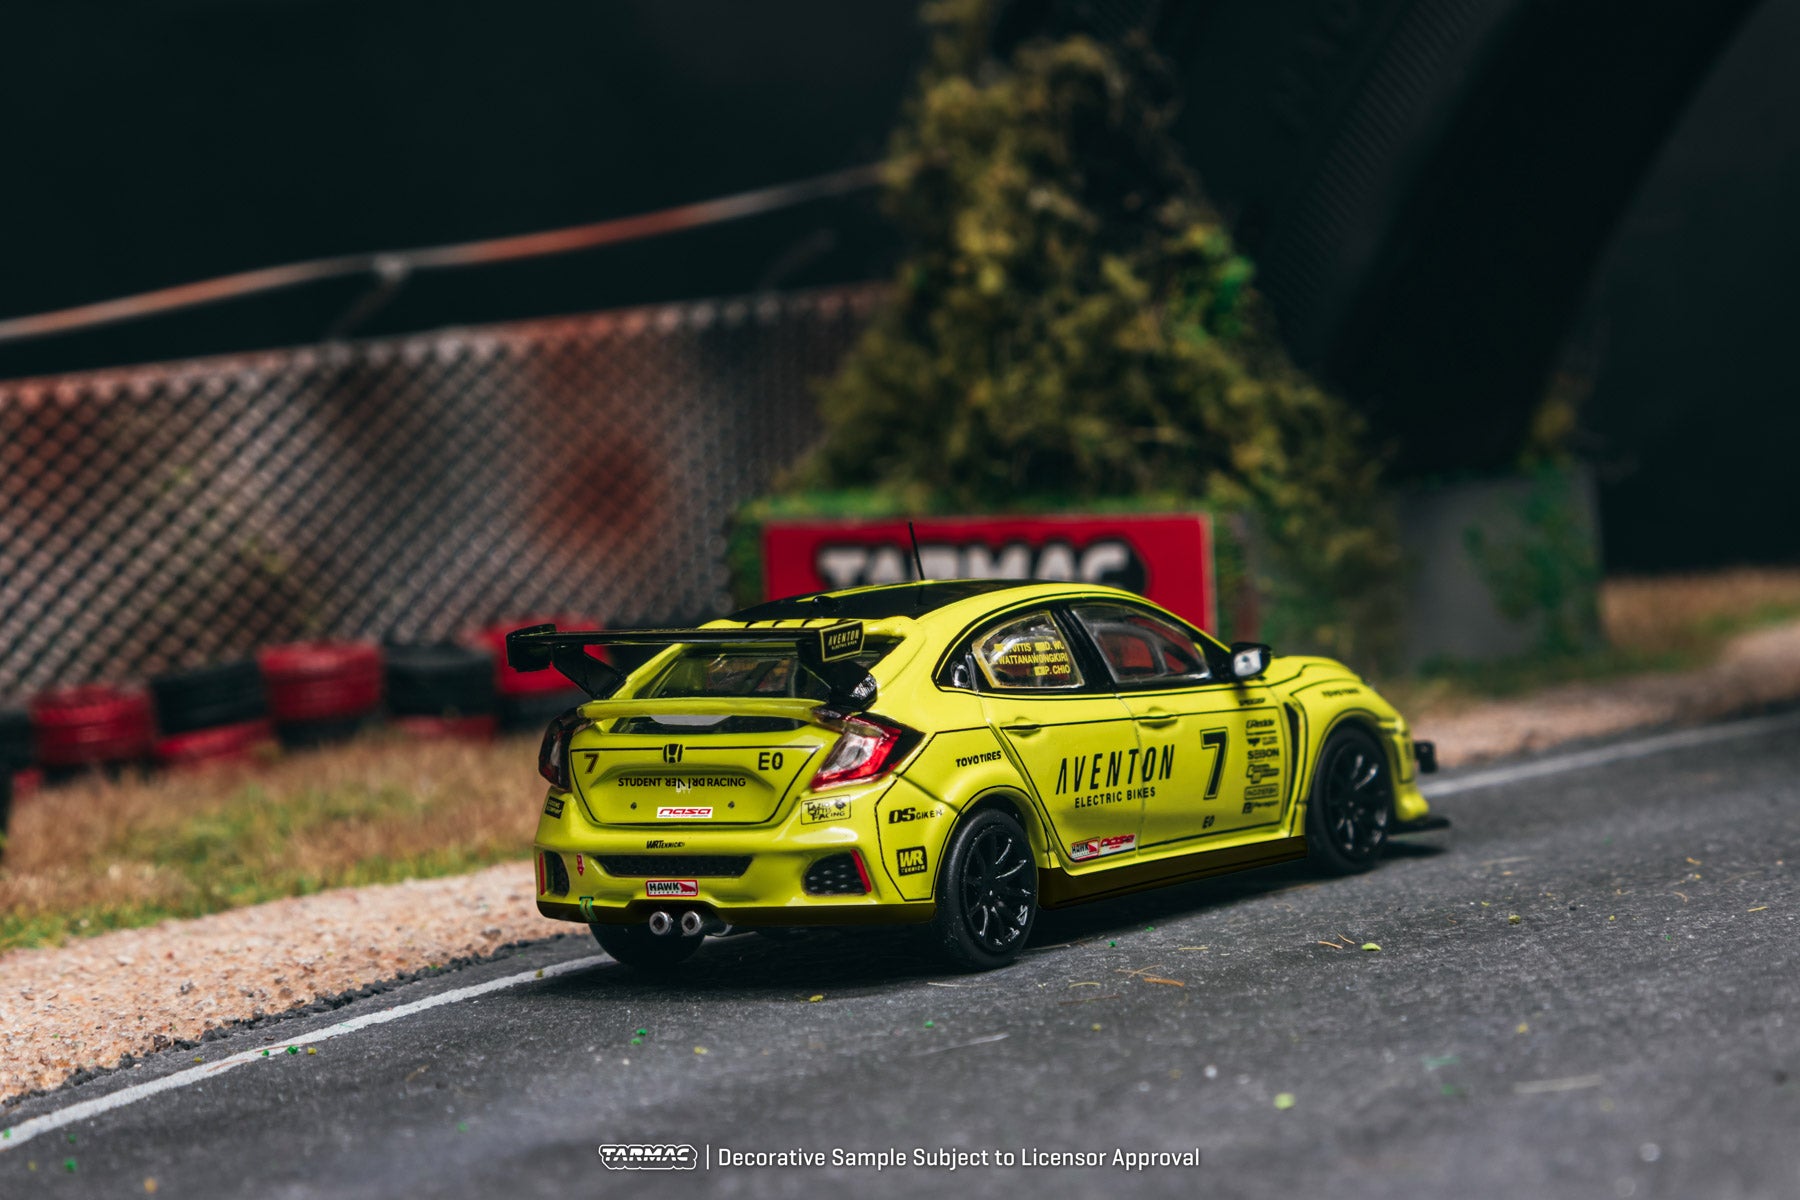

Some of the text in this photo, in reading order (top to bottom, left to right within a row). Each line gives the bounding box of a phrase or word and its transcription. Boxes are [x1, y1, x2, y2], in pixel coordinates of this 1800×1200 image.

[584, 753, 599, 775] 7
[1055, 744, 1175, 795] AVENTON
[1200, 726, 1230, 800] 7
[618, 777, 662, 787] STUDENT
[707, 777, 746, 787] RACING
[1074, 786, 1156, 808] ELECTRIC BIKES
[889, 807, 943, 824] OS GIKEN
[899, 849, 924, 868] WR
[648, 882, 680, 891] HAWK
